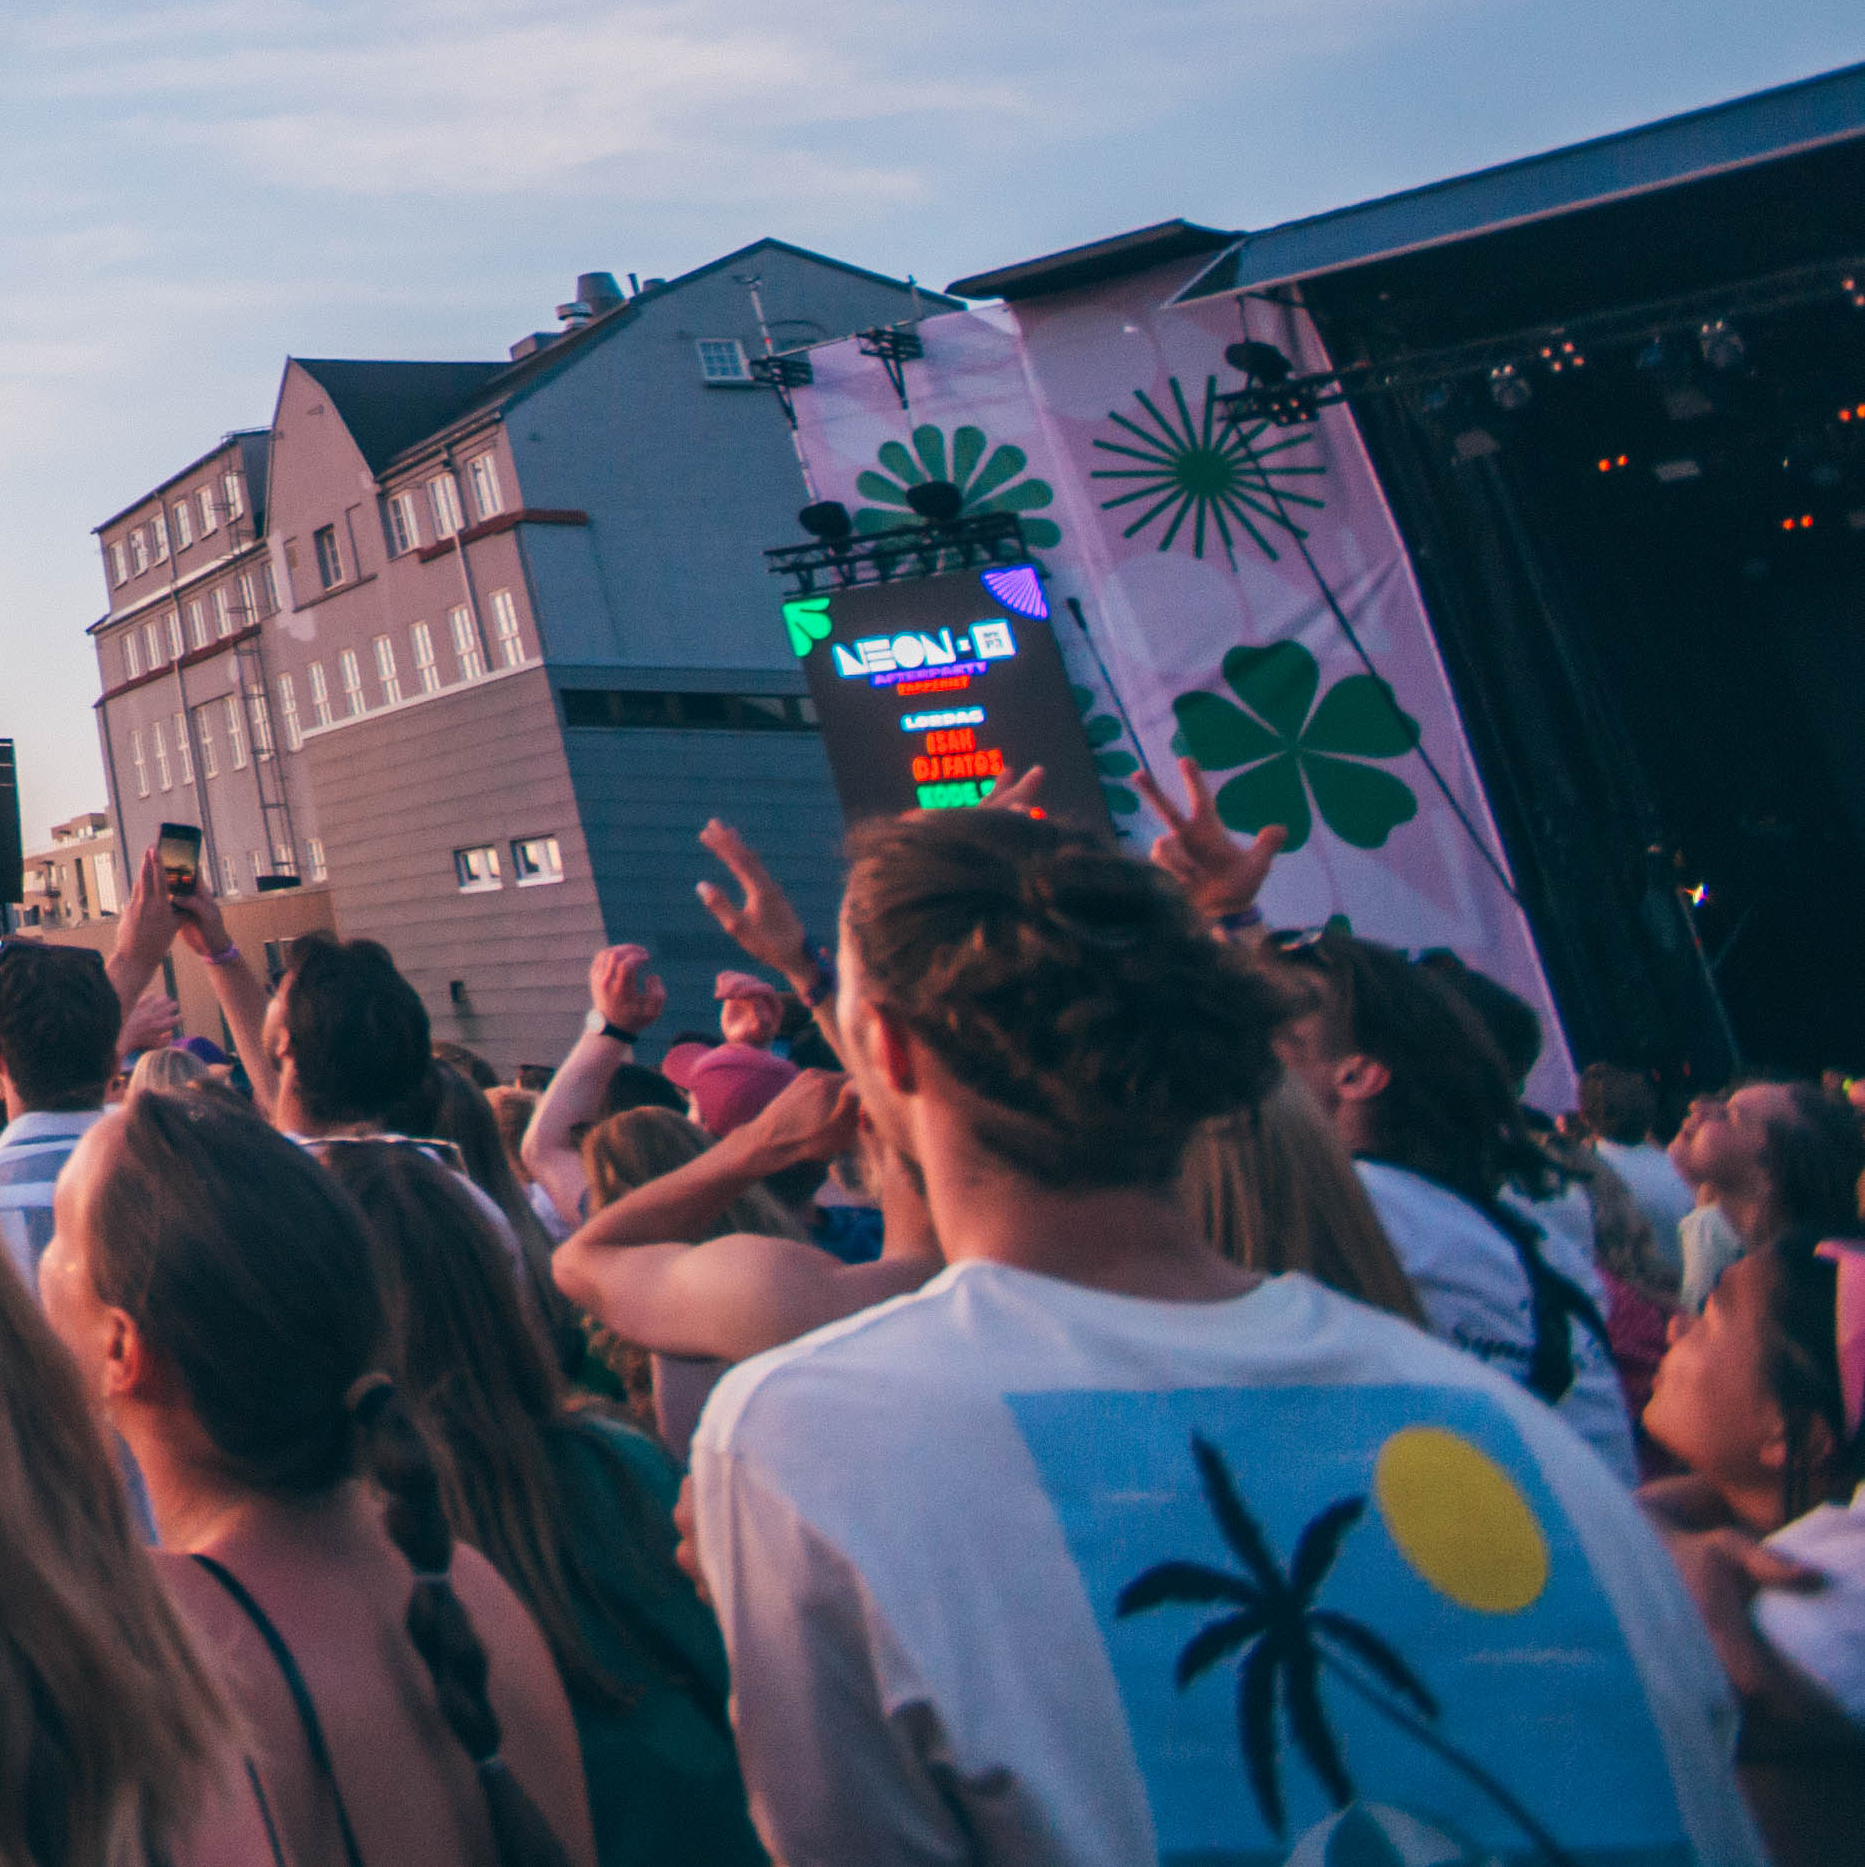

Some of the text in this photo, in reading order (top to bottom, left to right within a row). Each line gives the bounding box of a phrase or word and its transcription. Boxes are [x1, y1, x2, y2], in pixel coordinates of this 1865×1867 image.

[834, 627, 957, 676] NEON
[874, 661, 987, 685] AFTERPARTY
[912, 756, 941, 781] DJ
